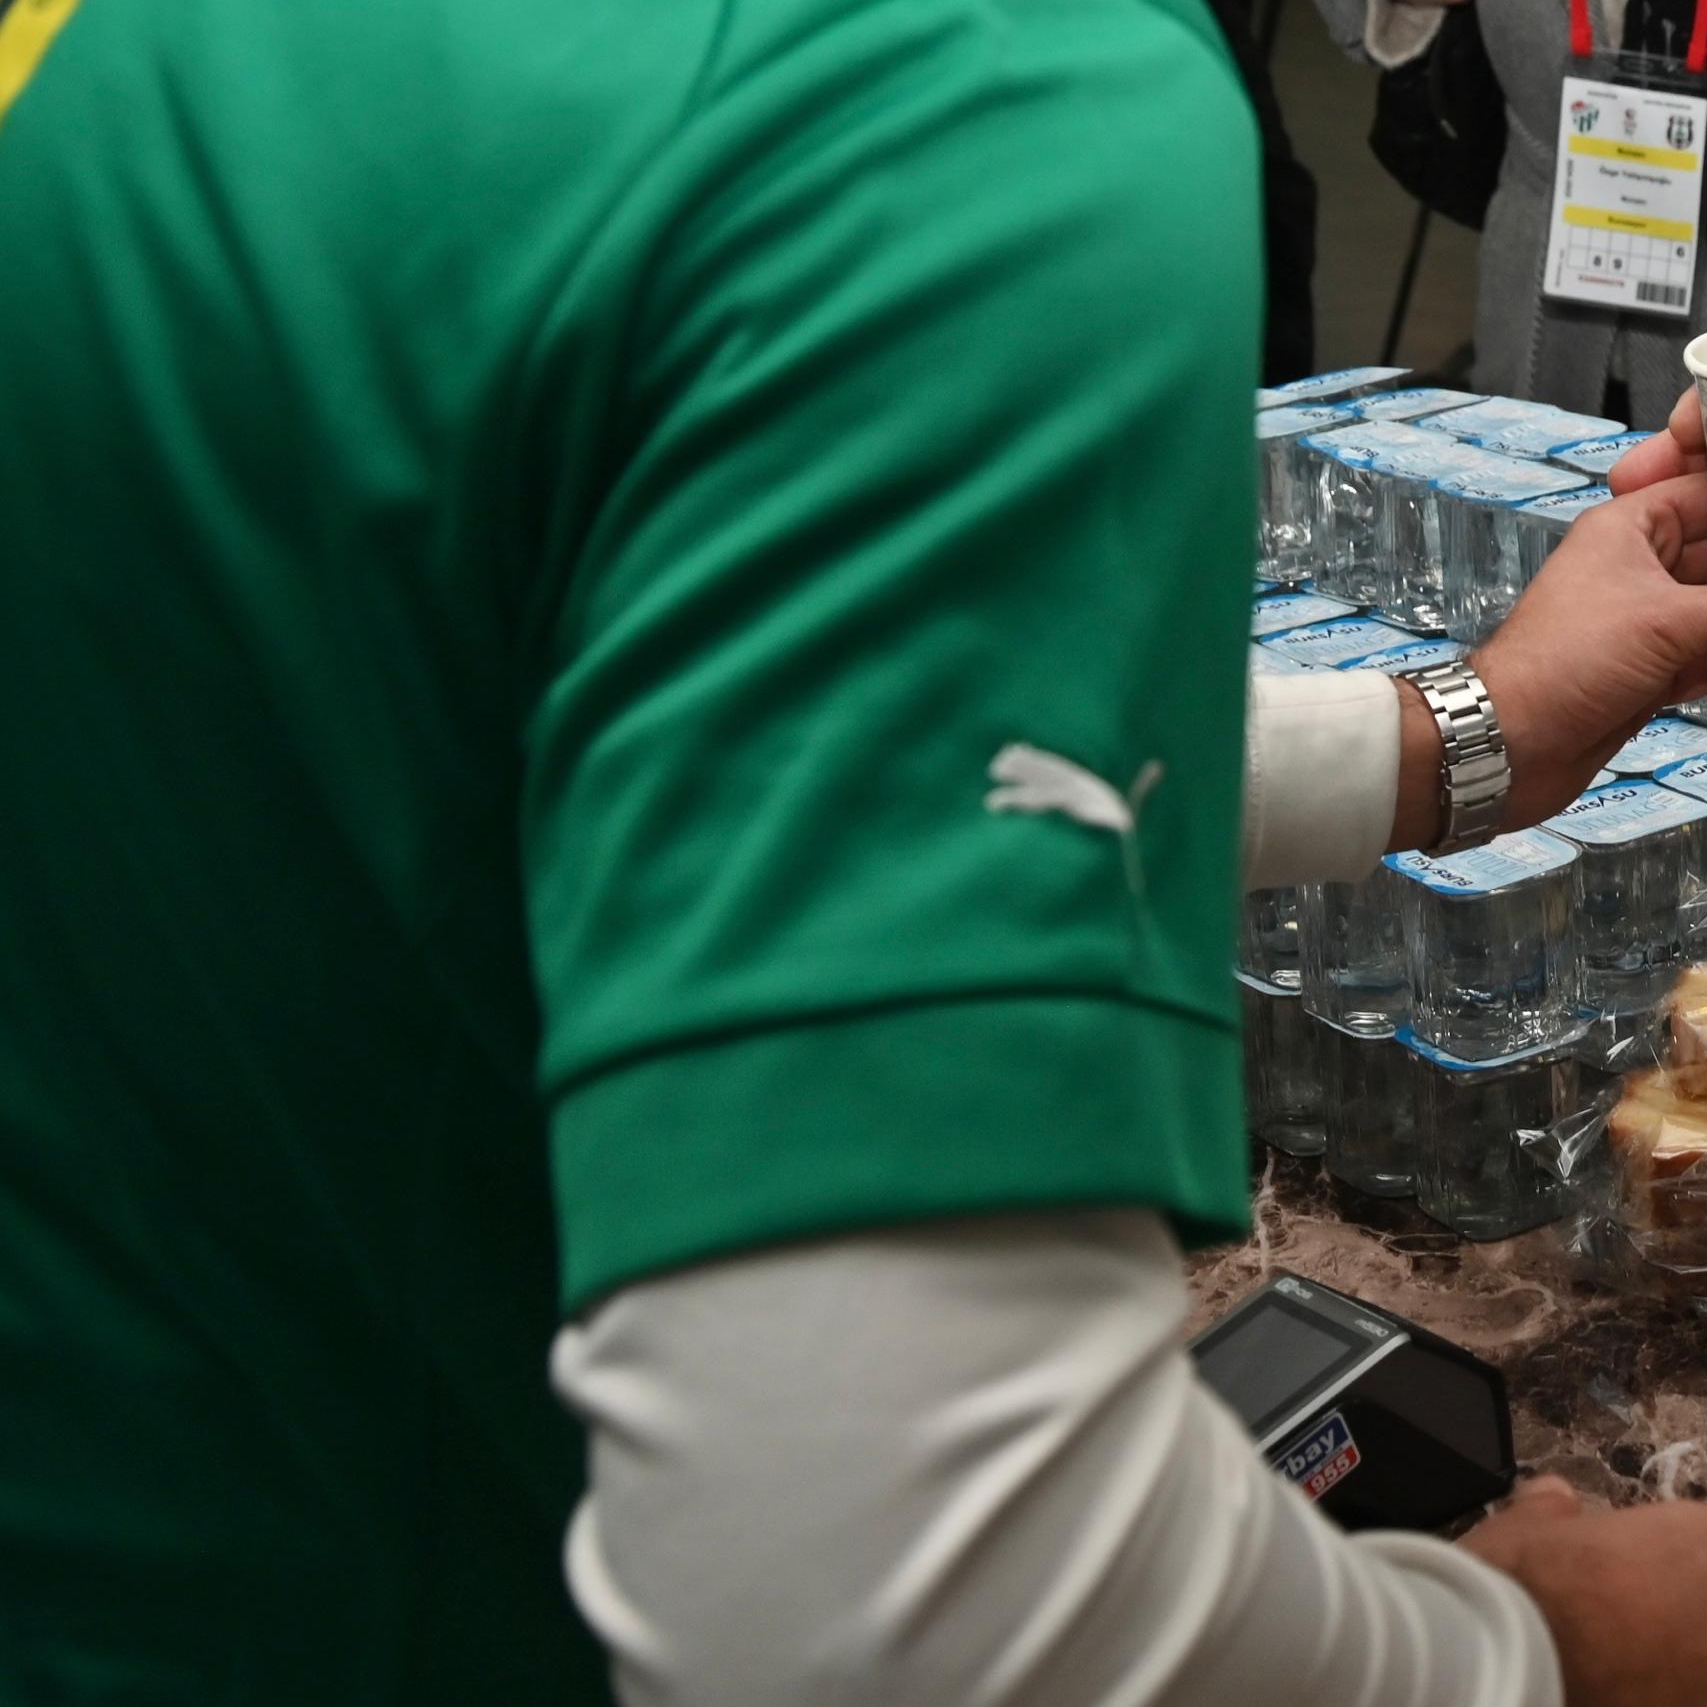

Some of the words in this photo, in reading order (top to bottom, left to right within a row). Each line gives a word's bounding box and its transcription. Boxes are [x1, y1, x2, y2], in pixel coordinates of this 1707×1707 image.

[1284, 625, 1364, 645] BURSASU
[1405, 855, 1474, 888] BURSASU
[1311, 1453, 1351, 1493] 955
